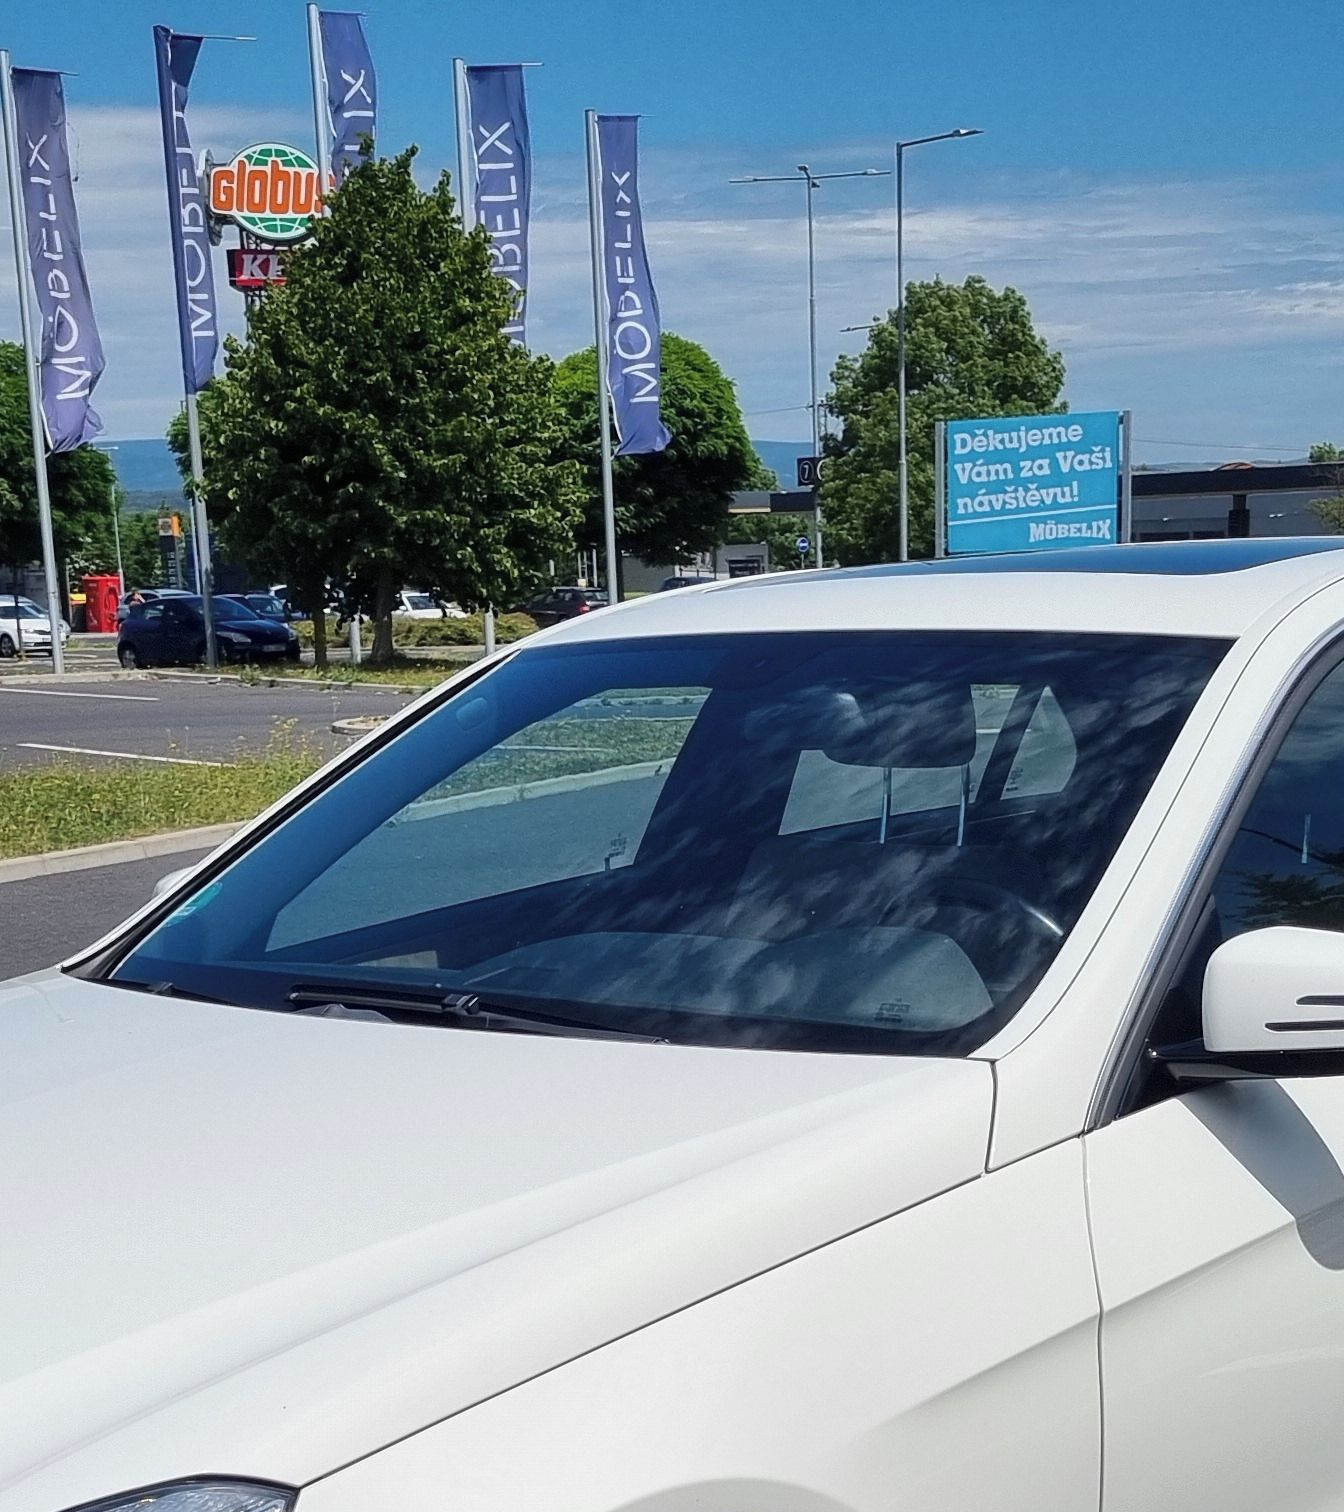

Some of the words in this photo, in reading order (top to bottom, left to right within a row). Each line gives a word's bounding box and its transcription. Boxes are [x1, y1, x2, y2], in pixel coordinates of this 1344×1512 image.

[953, 423, 1084, 455] Děkujeme
[953, 458, 1014, 485] Vám
[1019, 457, 1051, 478] za
[1056, 445, 1113, 474] Vaši
[957, 480, 1080, 515] návštěvu!
[1029, 518, 1112, 543] MÖBELIX
